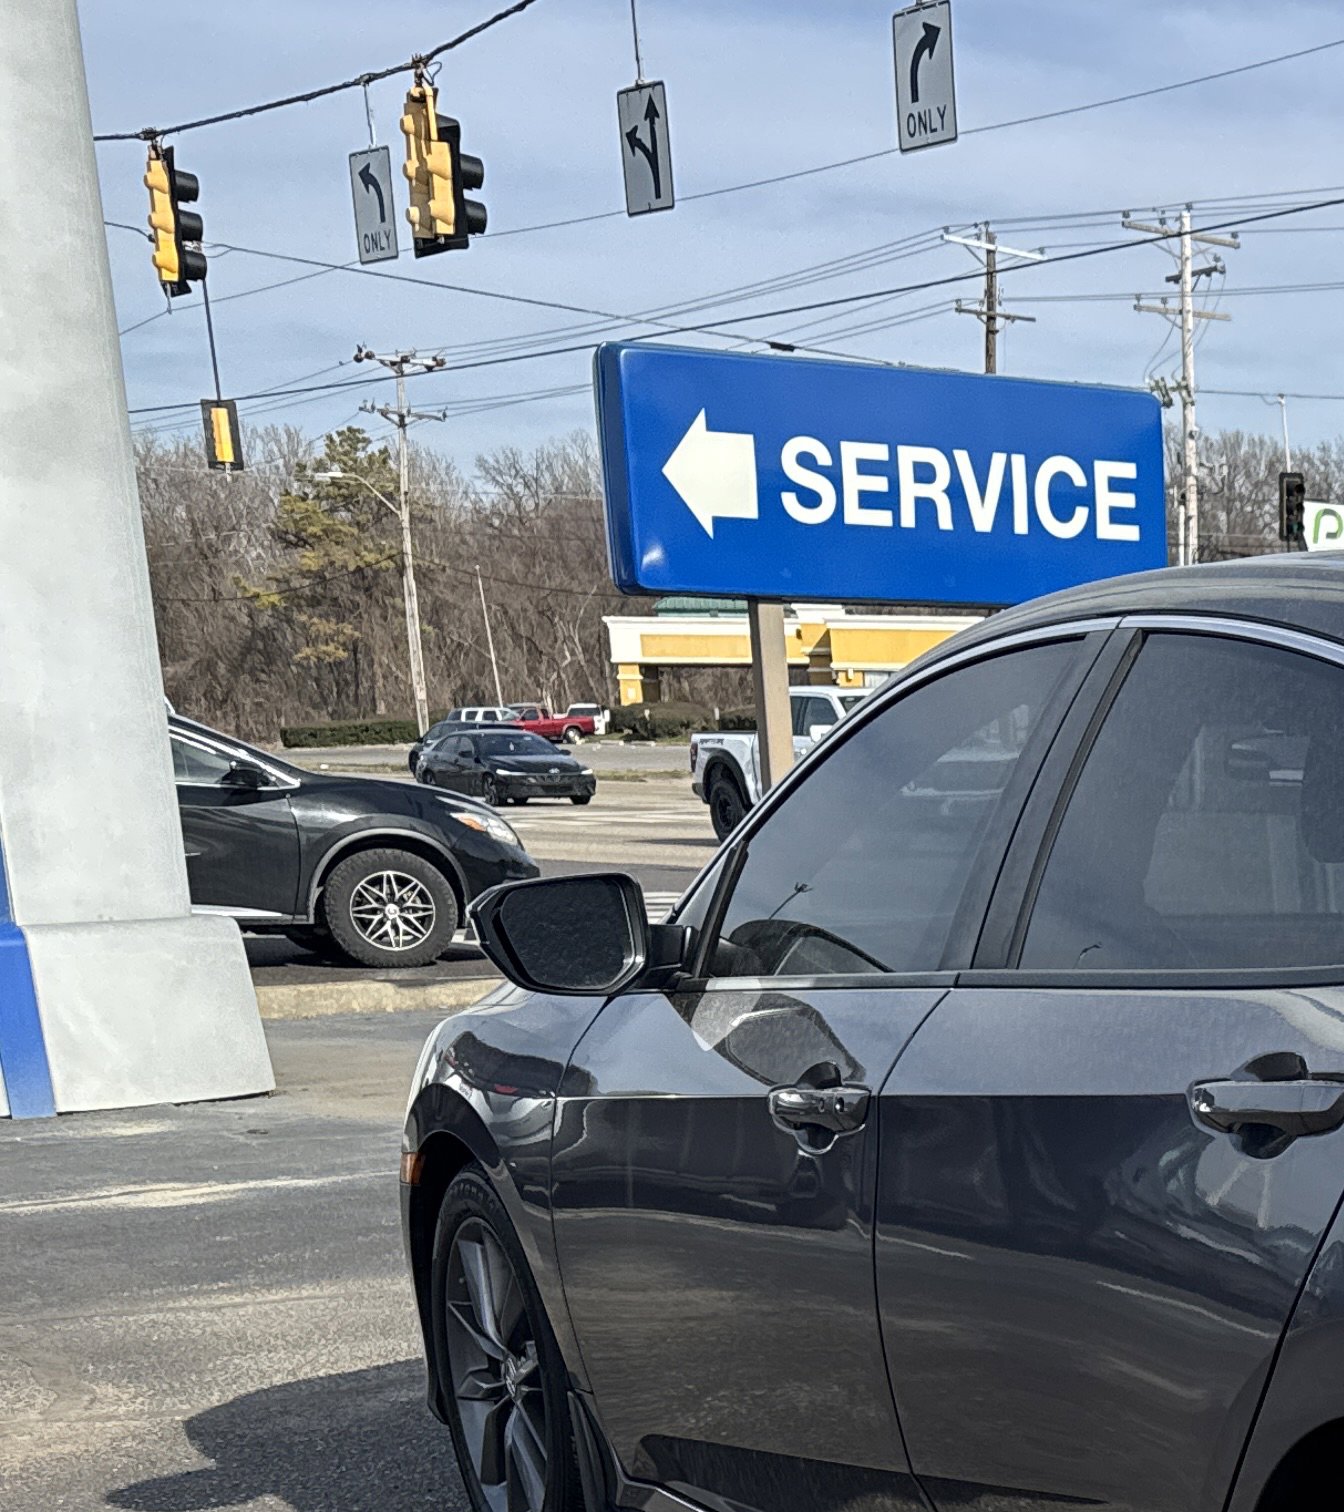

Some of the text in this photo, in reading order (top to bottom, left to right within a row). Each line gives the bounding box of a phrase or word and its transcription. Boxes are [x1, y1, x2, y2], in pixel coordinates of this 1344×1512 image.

[907, 104, 947, 138] ONLY
[363, 229, 391, 254] ONLY
[780, 435, 1140, 541] SERVICE
